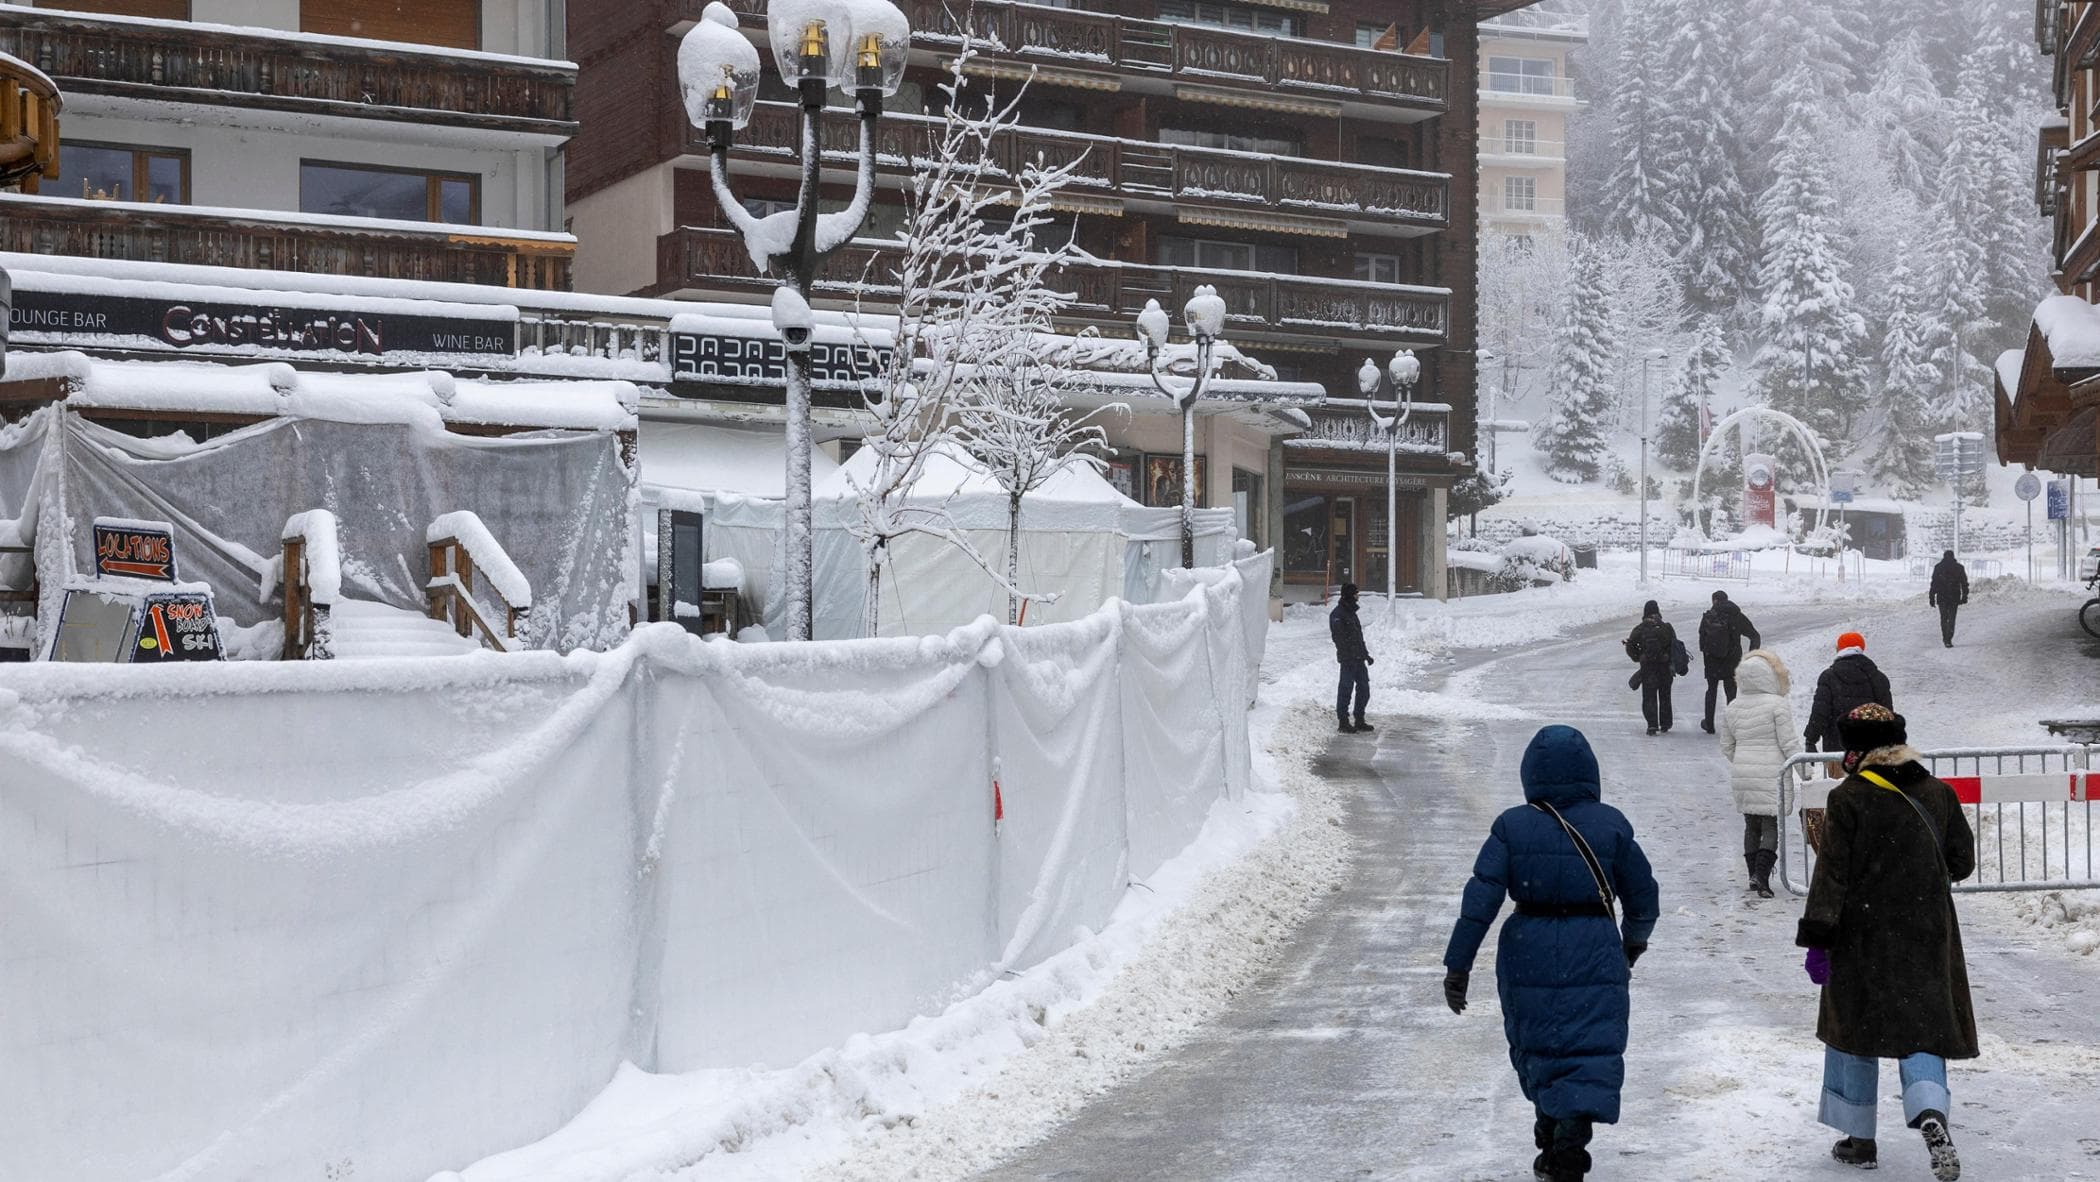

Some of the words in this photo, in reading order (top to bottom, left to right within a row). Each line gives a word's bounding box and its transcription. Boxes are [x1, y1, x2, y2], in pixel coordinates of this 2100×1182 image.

[9, 307, 69, 326] OUNGE
[74, 312, 107, 328] BAR
[432, 333, 471, 350] WINE
[474, 335, 504, 351] BAR
[1326, 475, 1385, 485] ARCHITECTURE
[97, 531, 169, 562] LOCATIONS
[166, 602, 203, 620] SNOW
[182, 634, 213, 651] SKI
